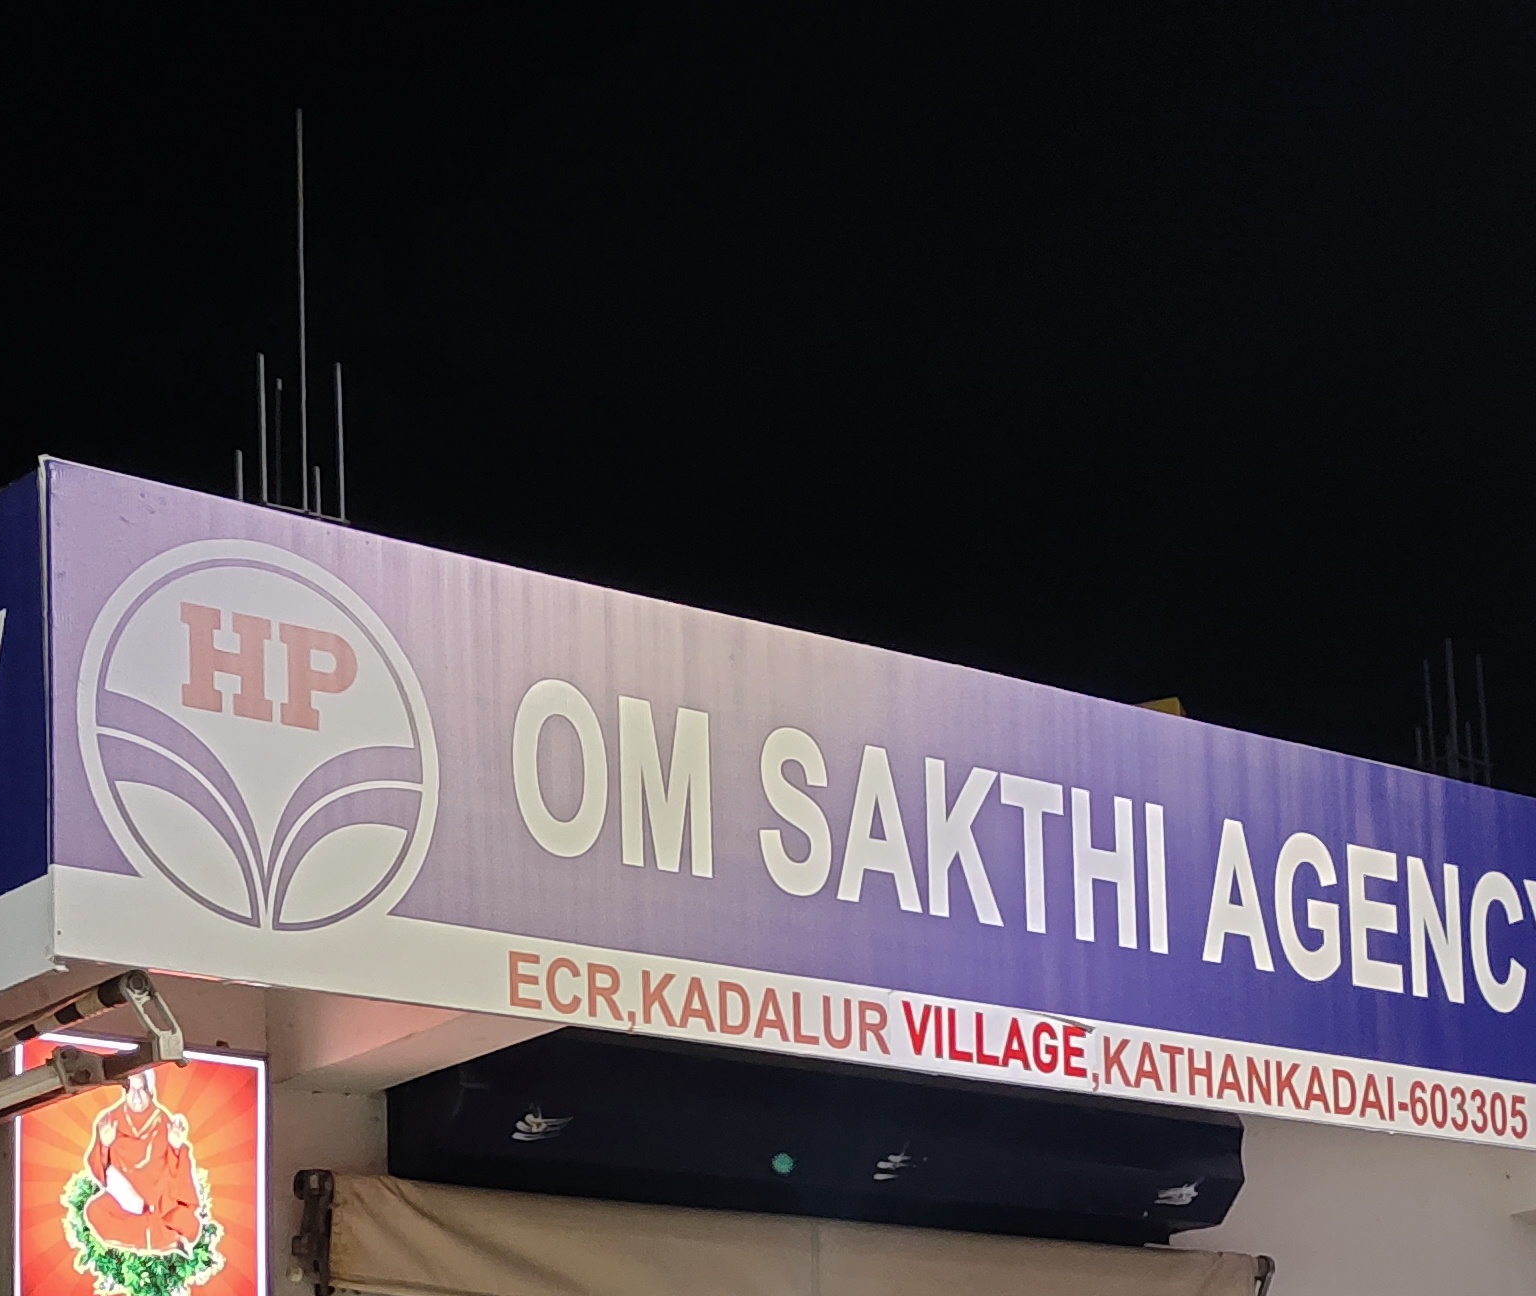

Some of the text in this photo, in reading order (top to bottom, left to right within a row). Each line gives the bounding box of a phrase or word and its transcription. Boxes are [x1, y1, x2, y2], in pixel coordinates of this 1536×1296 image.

[180, 602, 358, 731] HP
[512, 678, 715, 880] OM
[759, 726, 1169, 954] SAKTHI
